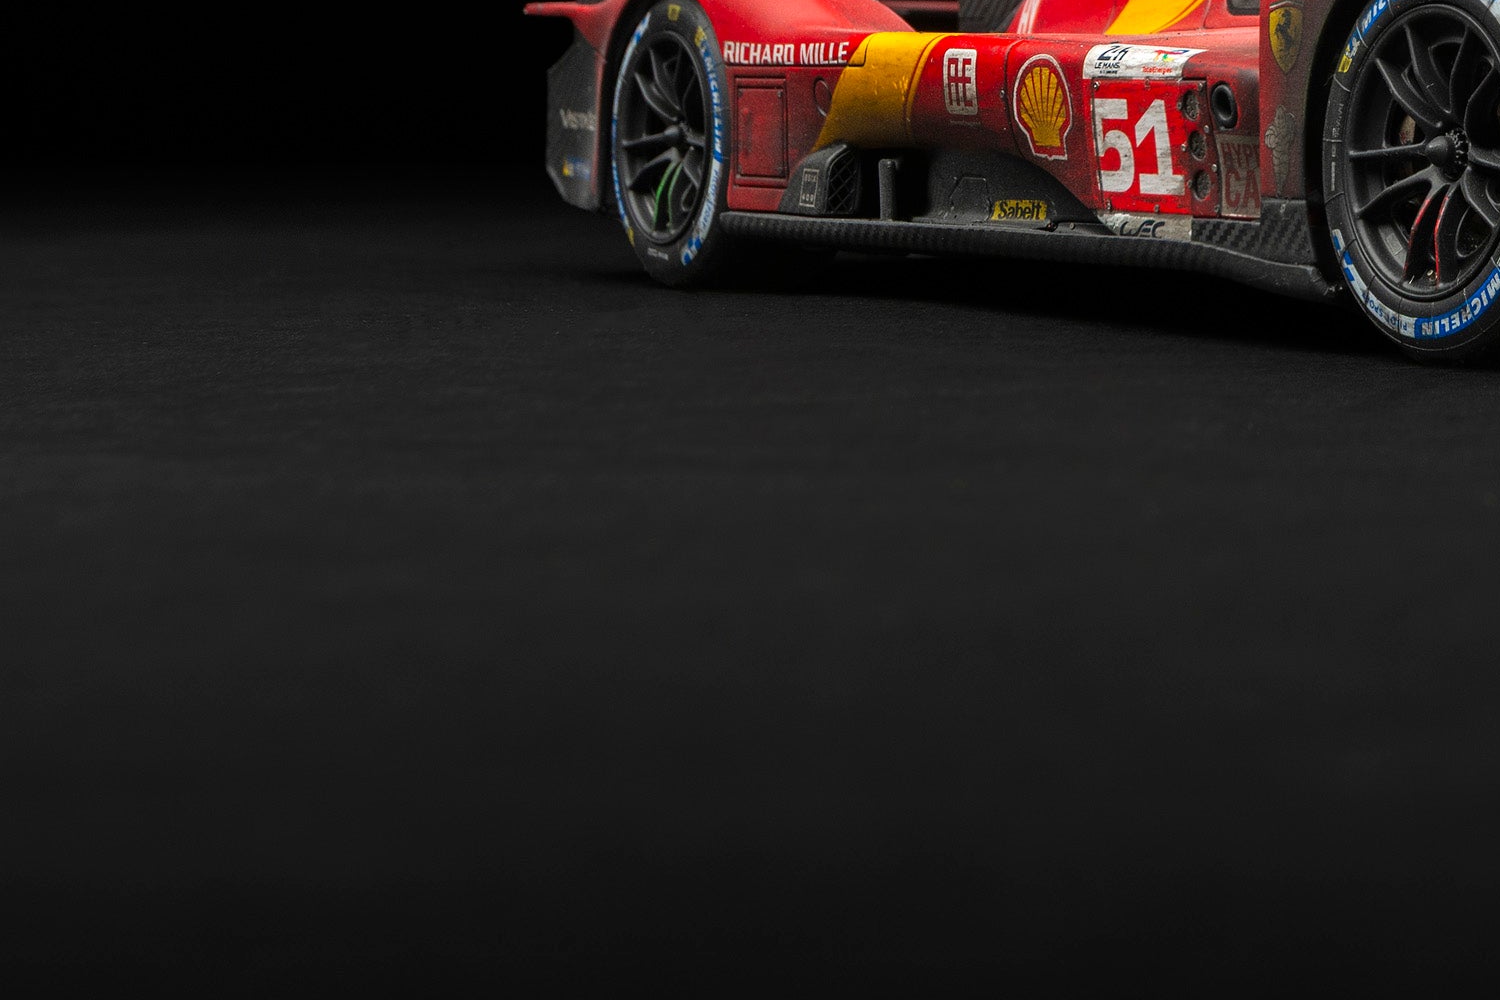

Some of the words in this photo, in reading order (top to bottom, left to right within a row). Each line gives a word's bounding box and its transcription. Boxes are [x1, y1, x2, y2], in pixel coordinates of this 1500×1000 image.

[724, 41, 795, 65] RICHARD
[800, 41, 850, 65] MILLE
[1091, 98, 1186, 195] 51
[998, 201, 1041, 220] Sabelt
